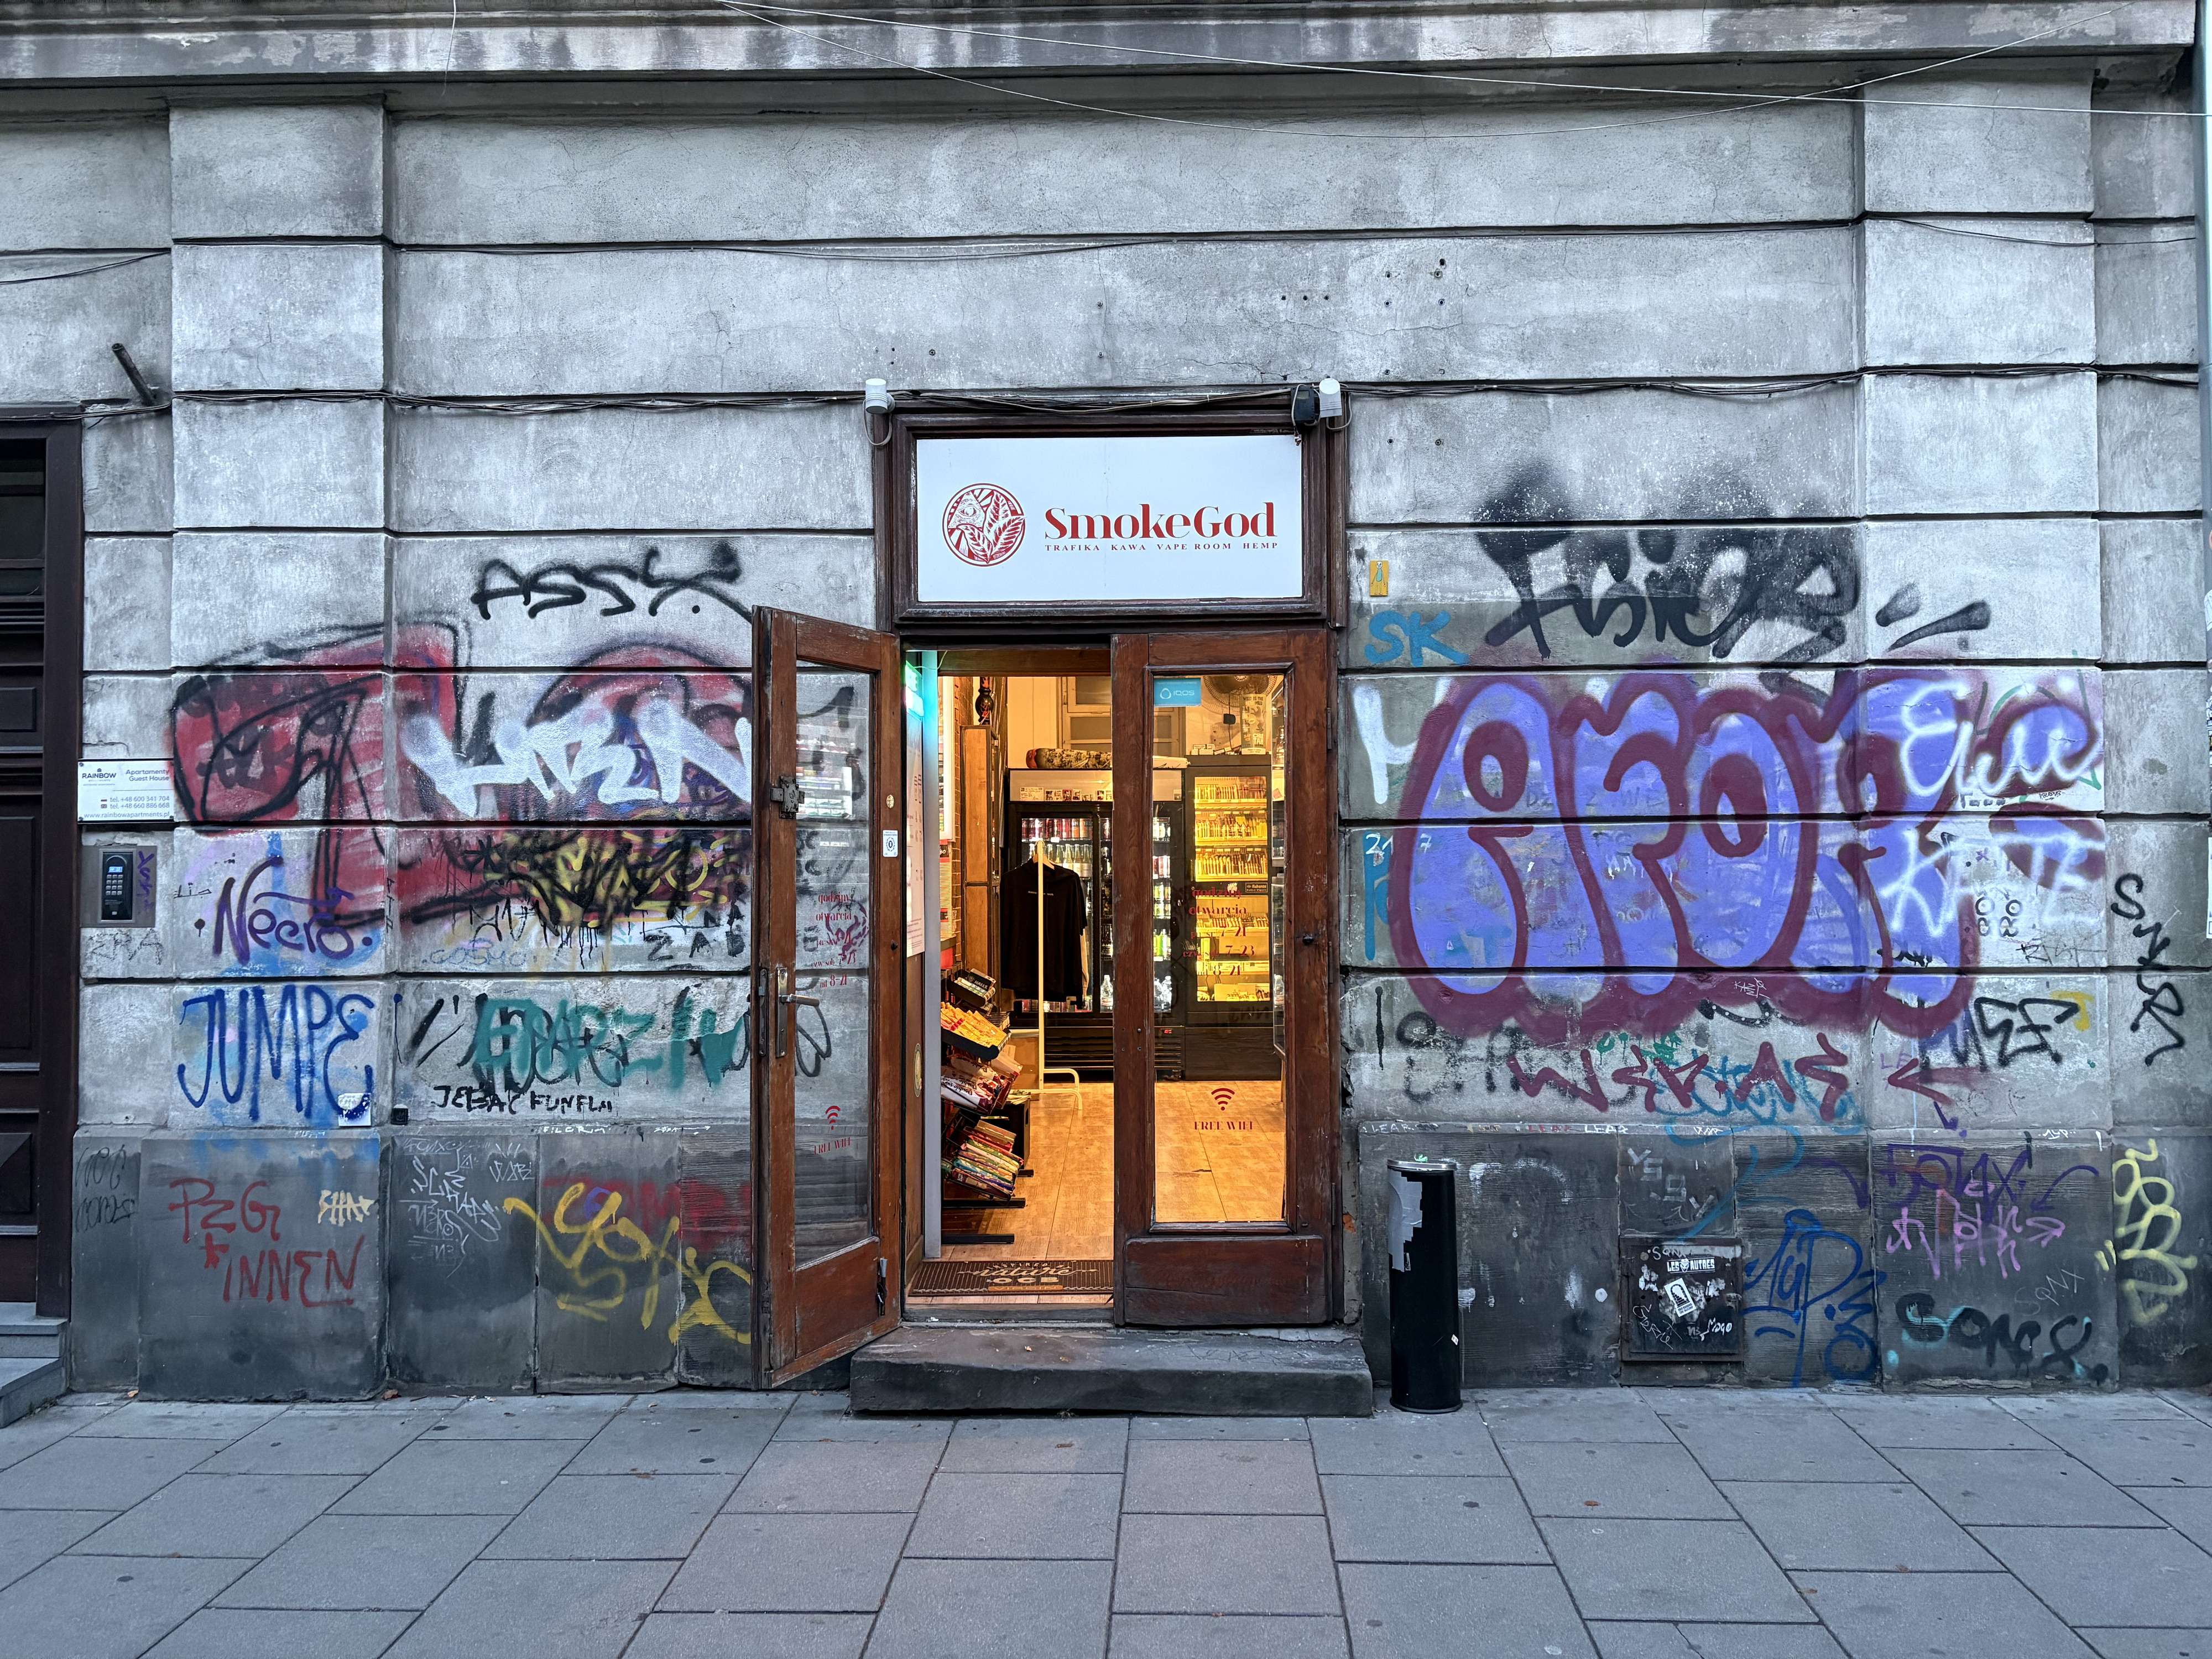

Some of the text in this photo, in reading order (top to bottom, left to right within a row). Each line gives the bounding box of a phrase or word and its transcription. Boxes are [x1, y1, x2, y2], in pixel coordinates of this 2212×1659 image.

[1364, 610, 1470, 666] SK
[1192, 887, 1243, 899] godziny
[1189, 904, 1247, 915] otwarcia
[973, 979, 988, 990] HALLS
[1194, 1120, 1254, 1130] FREE WIFI
[972, 1267, 1078, 1276] nature
[1667, 1261, 1680, 1272] LES
